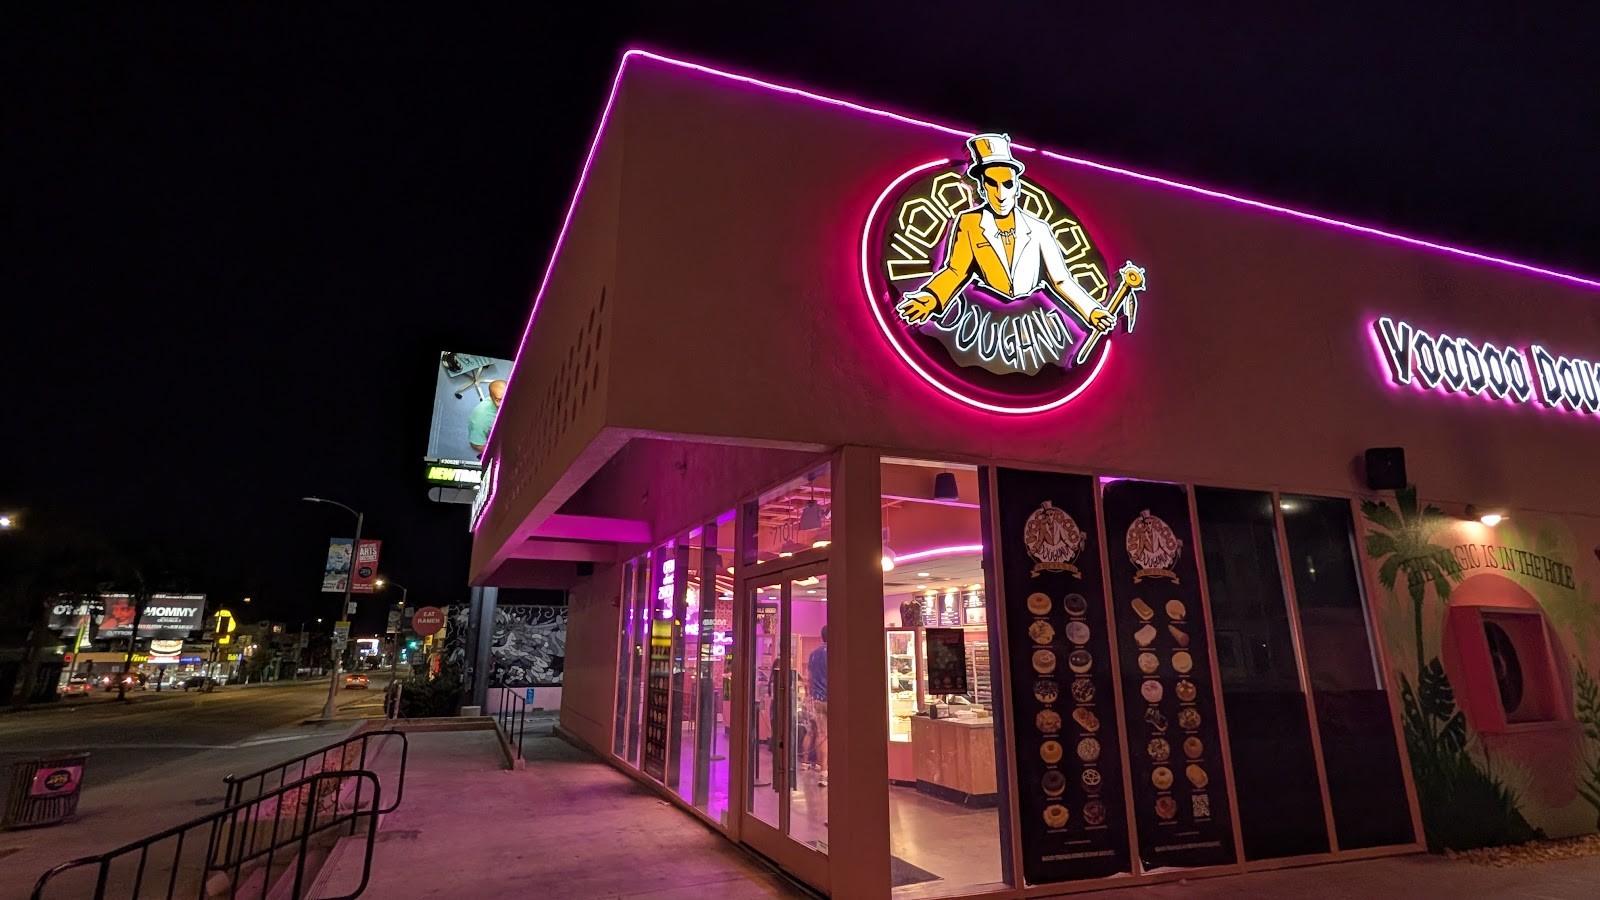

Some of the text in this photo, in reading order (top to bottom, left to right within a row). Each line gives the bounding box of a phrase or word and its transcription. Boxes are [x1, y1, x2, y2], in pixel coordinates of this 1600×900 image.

[934, 292, 1074, 371] DOUGHNUT
[1376, 316, 1532, 403] VOODOO
[360, 547, 377, 556] ARTS
[1481, 544, 1499, 569] IS
[1499, 546, 1516, 572] IN
[1515, 549, 1543, 580] THE
[1542, 556, 1576, 590] HOLE
[143, 606, 198, 617] MOMMY
